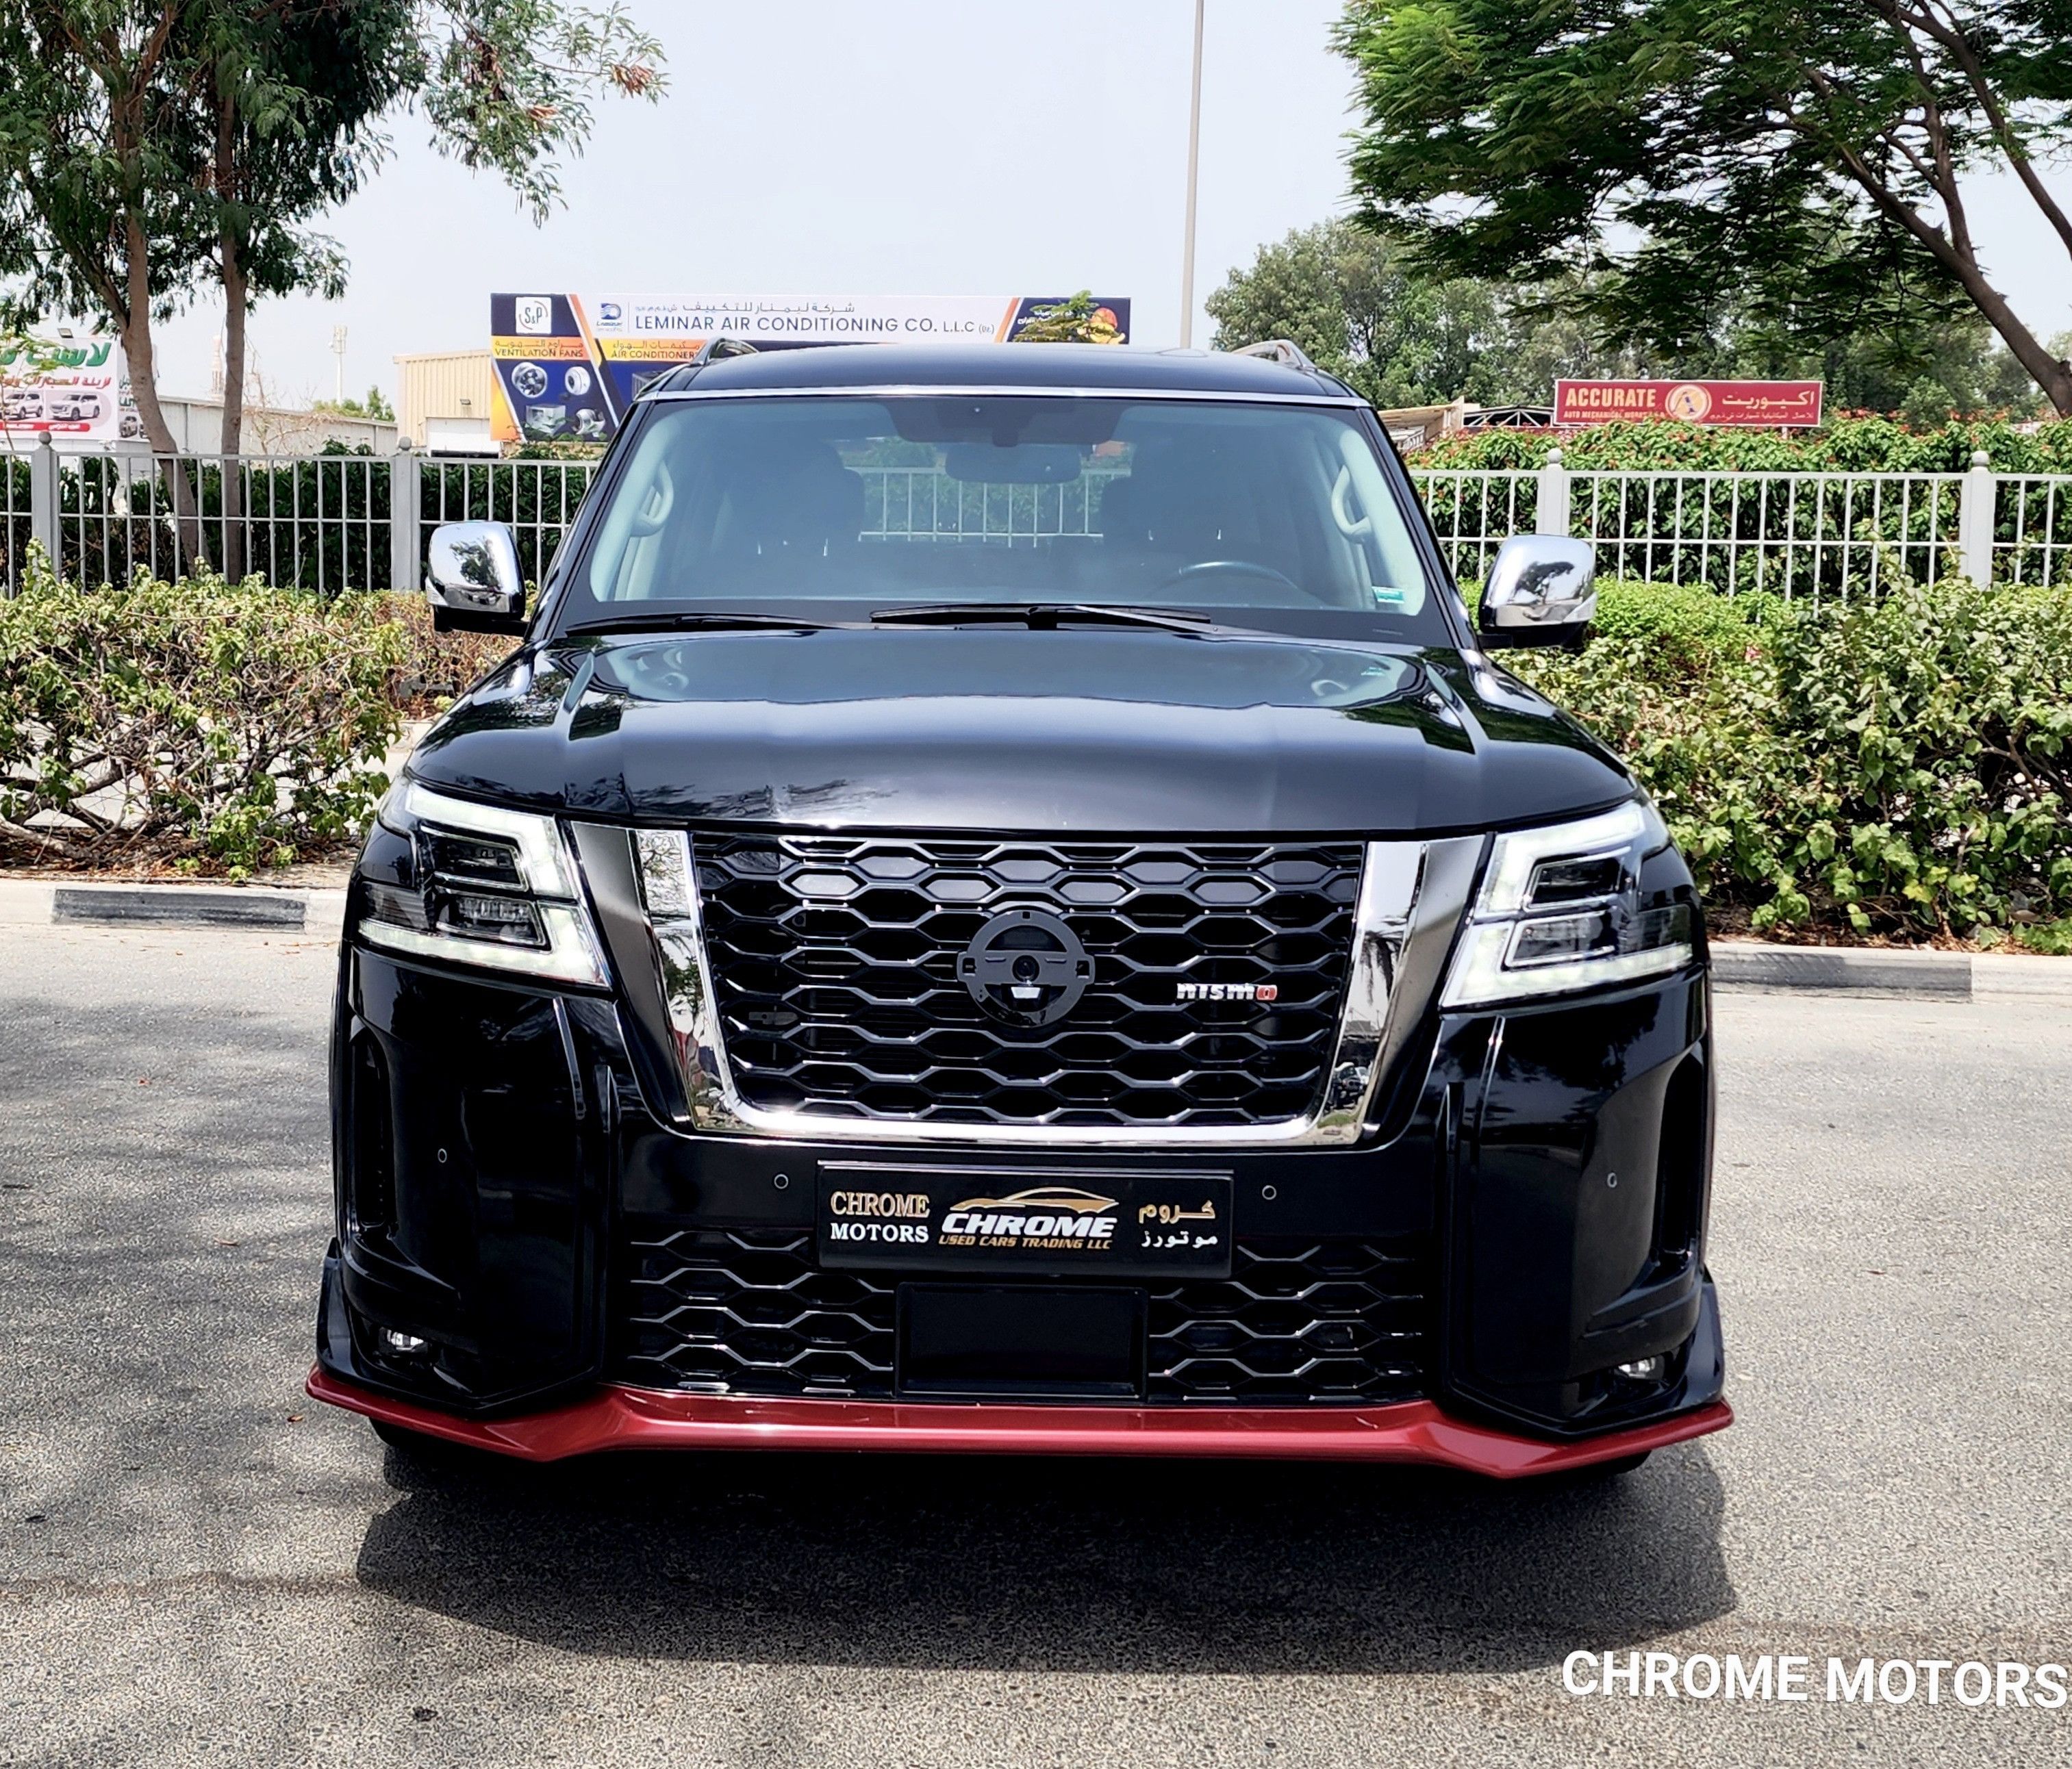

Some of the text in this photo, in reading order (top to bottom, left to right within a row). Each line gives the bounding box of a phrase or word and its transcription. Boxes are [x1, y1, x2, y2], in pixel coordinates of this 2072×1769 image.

[683, 301, 753, 314] للتكييف
[755, 302, 809, 315] ليمنار
[811, 302, 855, 315] شركة
[525, 307, 542, 324] S&P
[635, 316, 714, 330] LEMINAR
[721, 317, 750, 331] AIR
[757, 317, 898, 332] CONDITIONING
[905, 318, 937, 332] CO.
[944, 321, 974, 332] L.L.C
[495, 340, 583, 348] مراوح التهوية
[652, 340, 700, 350] مكيفات
[494, 348, 556, 357] VENTILATION
[611, 351, 698, 359] AIR CONDITIONER
[1565, 387, 1656, 407] ACCURATE
[1722, 390, 1815, 409] اكيوريت
[1564, 411, 1580, 419] AUTO
[831, 1191, 931, 1218] CHROME
[1139, 1200, 1216, 1224] كروم
[942, 1213, 1117, 1238] CHROME
[830, 1223, 929, 1243] MOTORS
[939, 1235, 1113, 1249] USED CARS TRADING LLC
